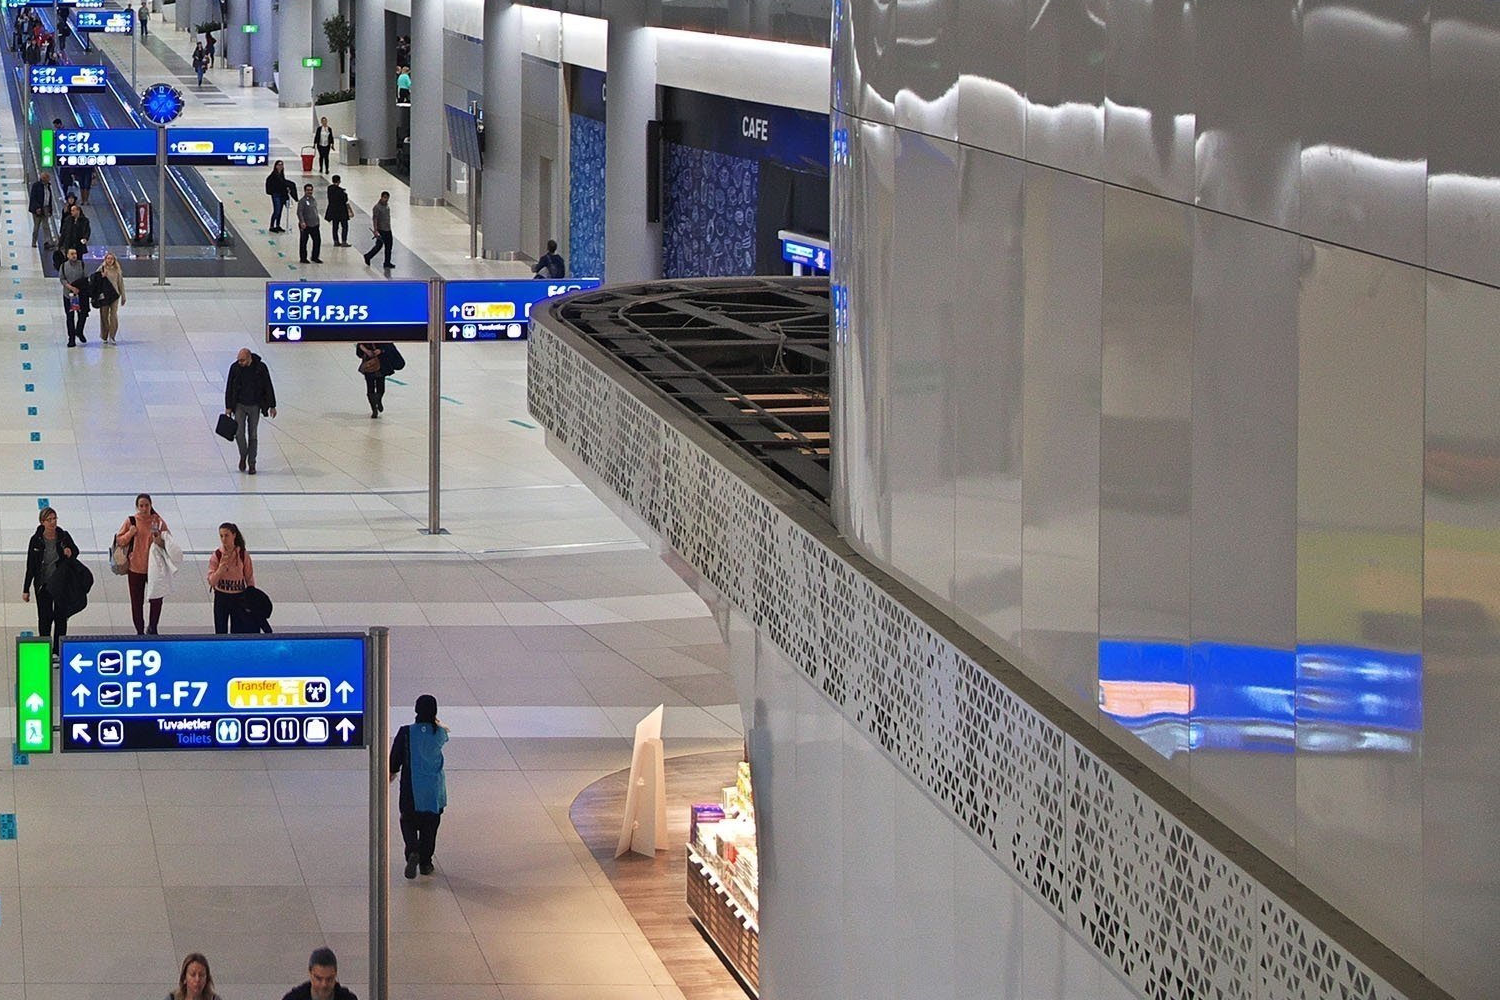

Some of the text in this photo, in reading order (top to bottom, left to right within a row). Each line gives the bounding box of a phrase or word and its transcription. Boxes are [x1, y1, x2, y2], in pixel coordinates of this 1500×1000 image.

[742, 115, 769, 141] CAFE
[77, 132, 91, 142] F7
[77, 142, 248, 153] F1-5 F6
[302, 287, 323, 303] F7
[302, 305, 369, 322] F1,F3,F5
[125, 649, 162, 677] F9
[235, 679, 277, 691] Transfer
[125, 680, 209, 708] F1-F7
[156, 718, 213, 731] Tuvaletler
[176, 733, 213, 745] Toilets
